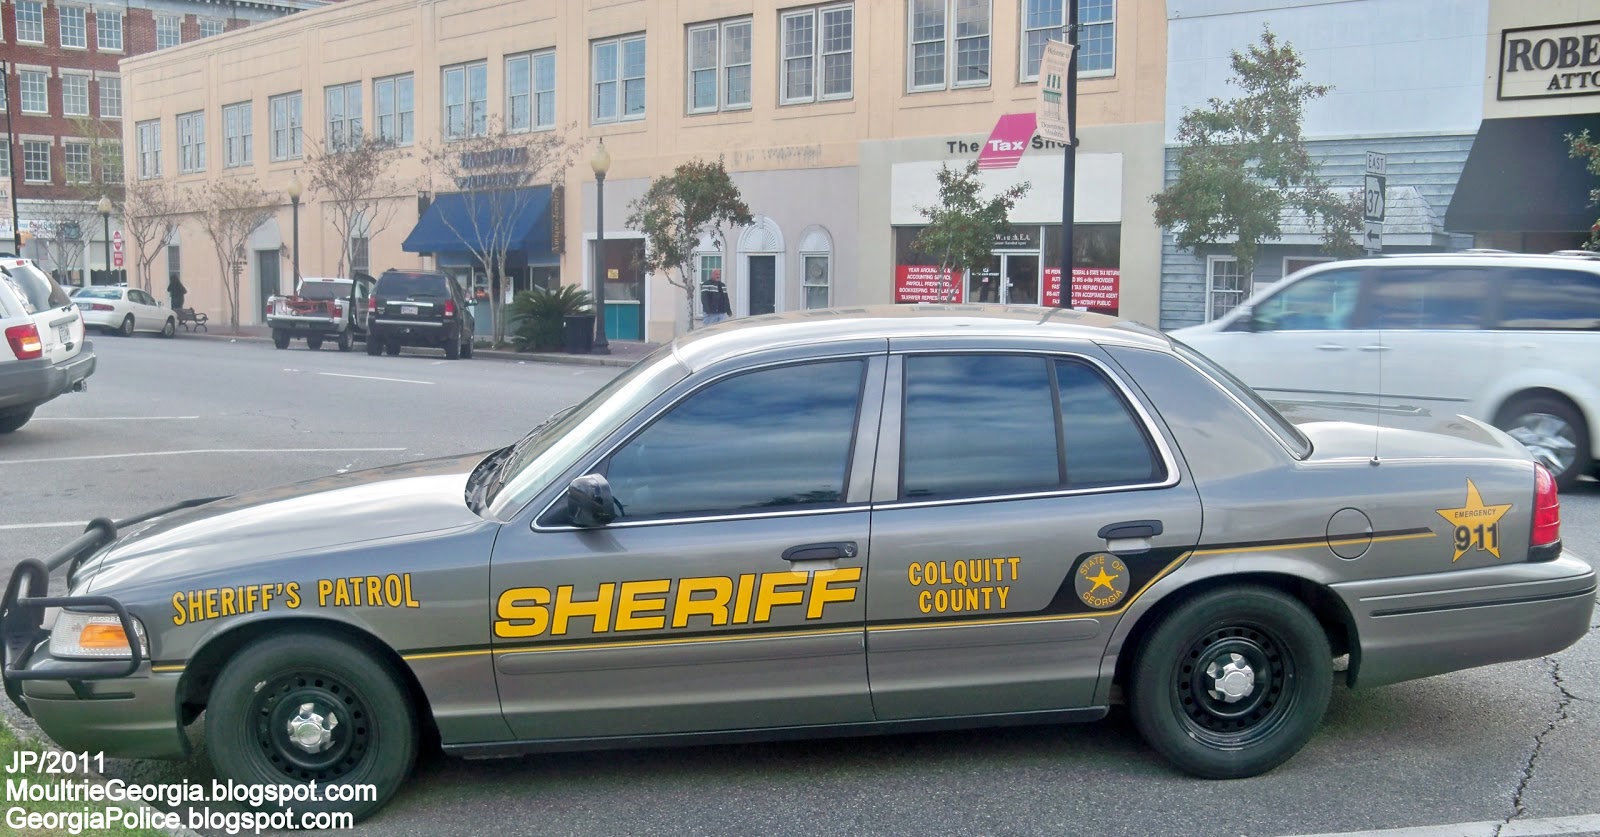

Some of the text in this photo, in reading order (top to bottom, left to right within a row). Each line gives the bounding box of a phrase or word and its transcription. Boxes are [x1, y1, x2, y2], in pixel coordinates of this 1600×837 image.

[946, 134, 1080, 154] The Tax Sh
[1368, 154, 1384, 171] EAST
[1366, 189, 1380, 214] 37
[1454, 508, 1497, 519] EMERGENCY
[1454, 522, 1499, 551] 911
[908, 556, 1021, 587] COLQUITT
[1080, 555, 1125, 576] STATE OF
[172, 572, 421, 627] SHERIFF'S PATROL
[493, 566, 863, 639] SHERIFF
[917, 585, 1011, 614] COUNTY
[1082, 589, 1123, 607] GEORGIA
